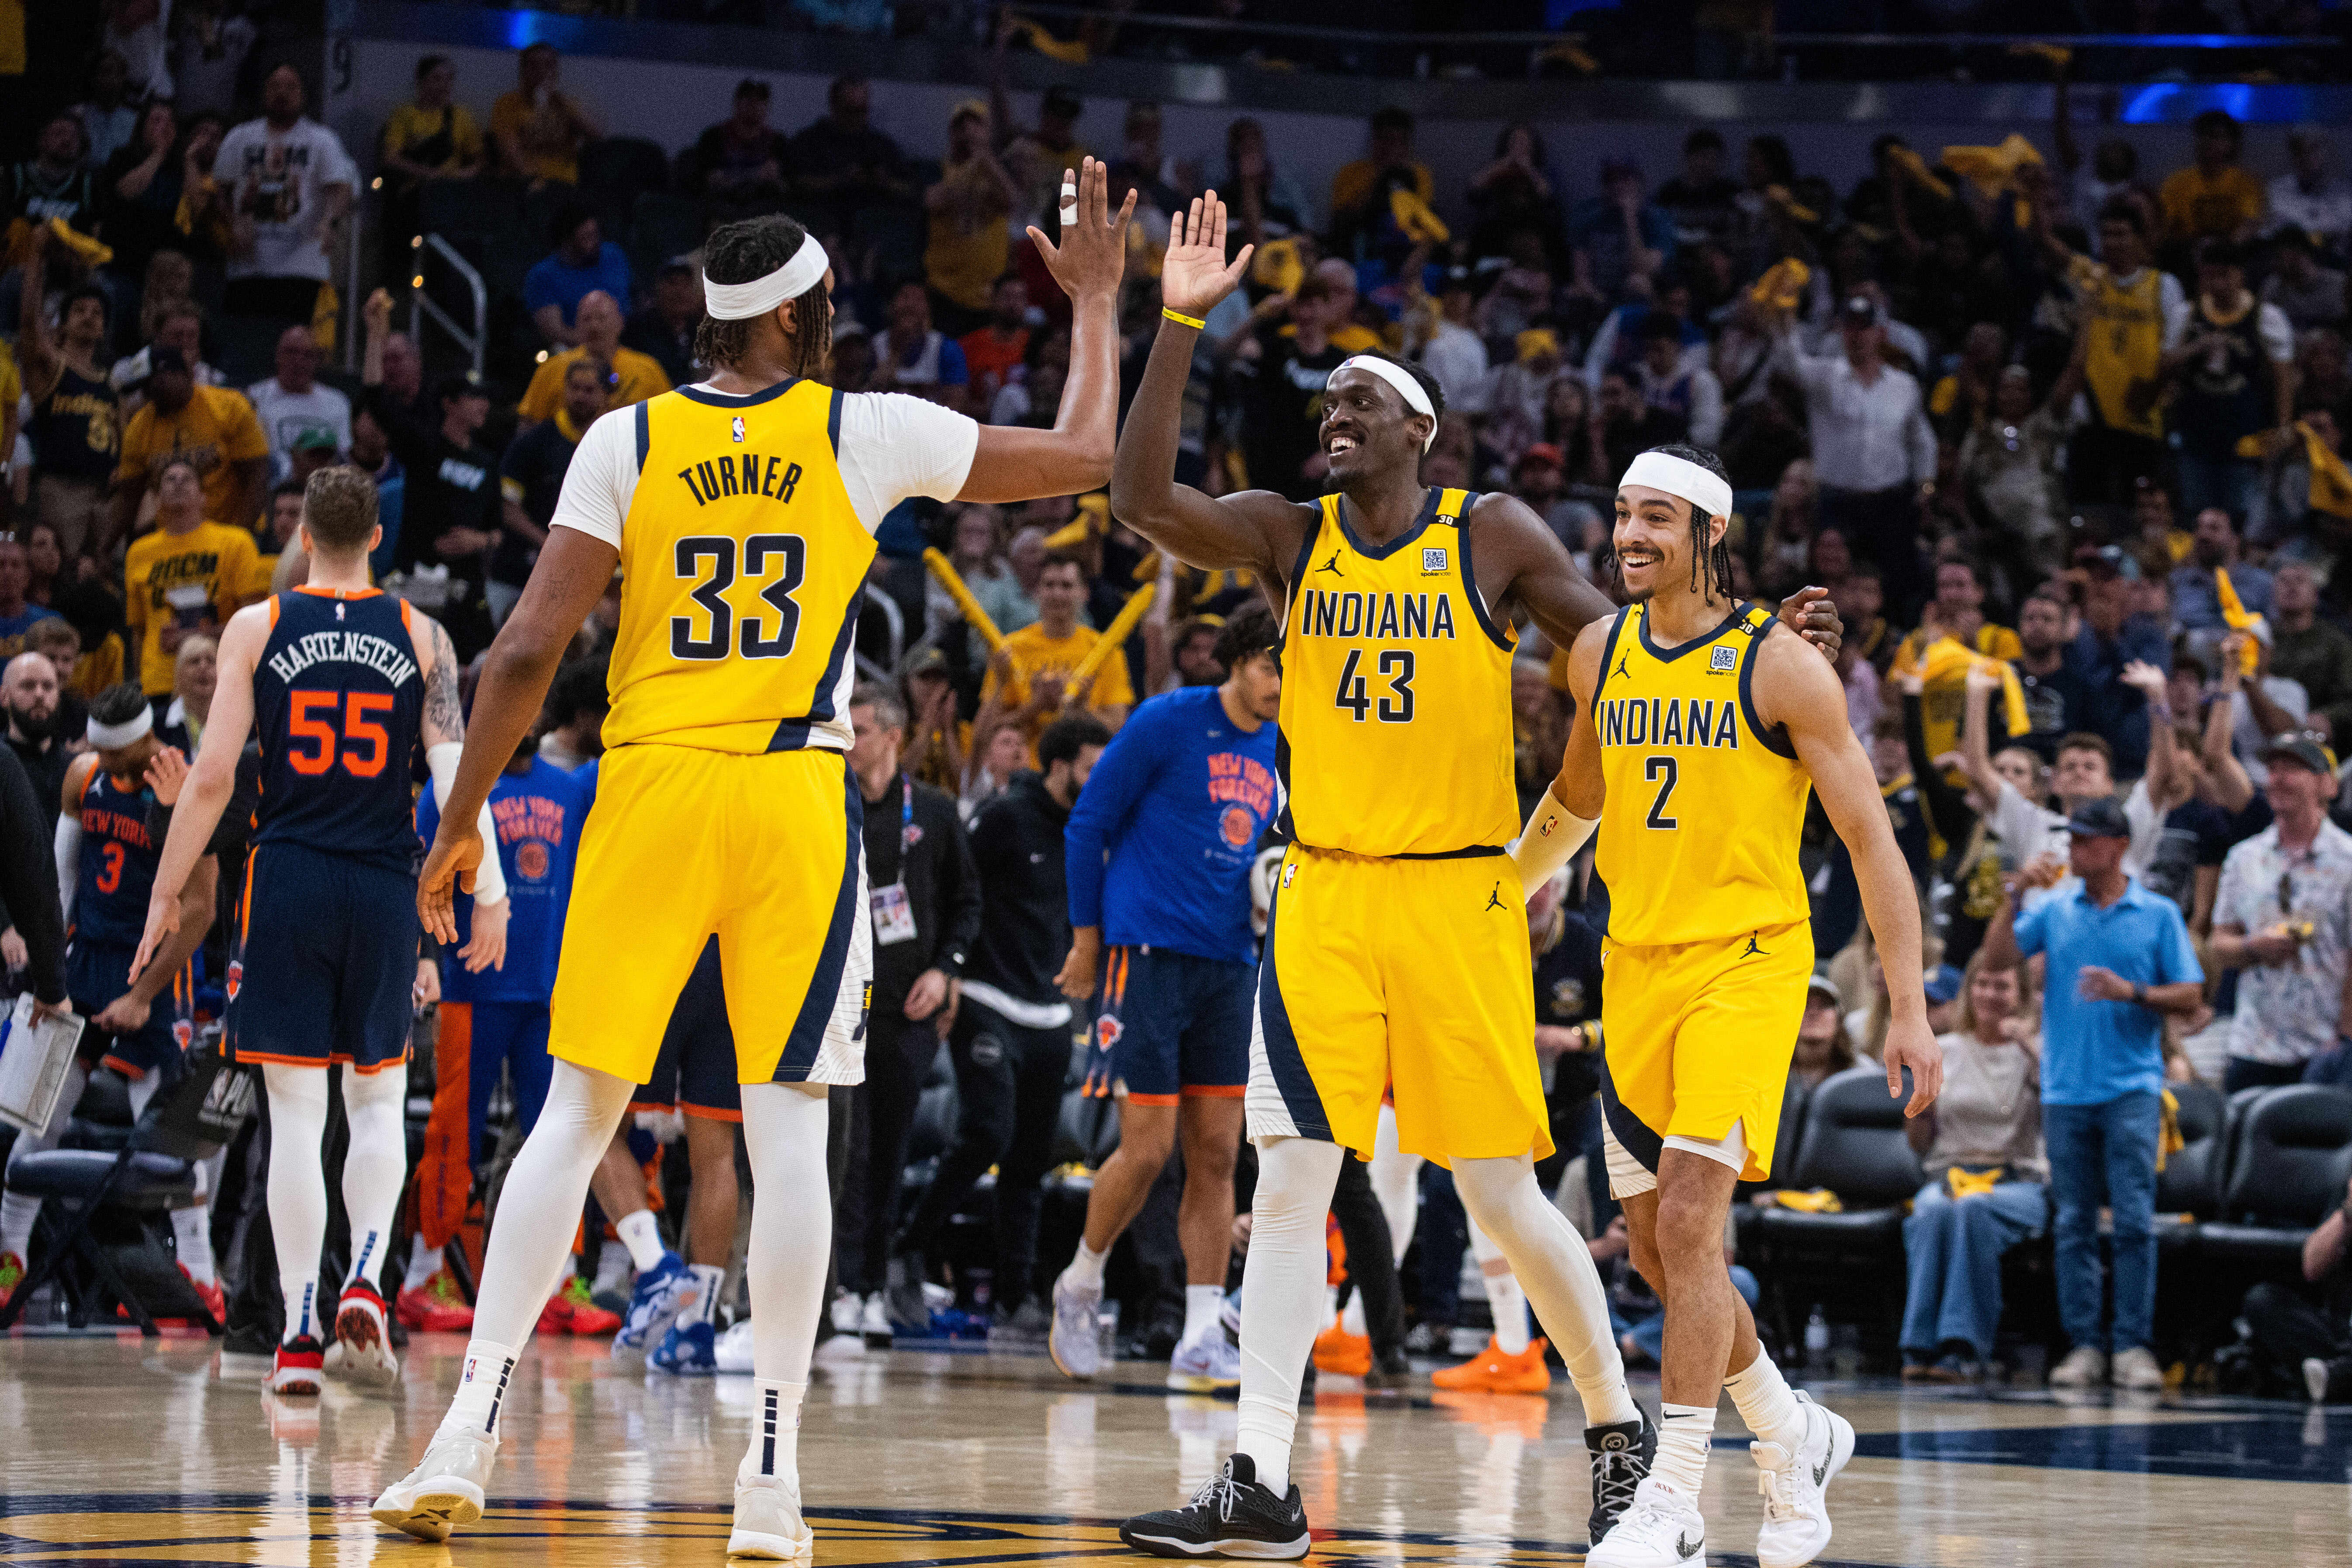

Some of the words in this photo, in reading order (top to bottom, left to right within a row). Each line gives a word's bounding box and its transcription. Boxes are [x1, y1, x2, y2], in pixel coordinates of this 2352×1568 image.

[678, 454, 802, 506] TURNER
[1439, 515, 1454, 526] 30
[670, 533, 807, 661] 33
[1301, 588, 1456, 640] INDIANA
[268, 631, 417, 688] HARTENSTEIN
[1335, 648, 1416, 723] 43
[289, 690, 394, 778] 55
[1600, 697, 1739, 750] INDIANA
[1644, 755, 1678, 830] 2
[82, 809, 111, 834] NEW
[96, 841, 125, 893] 3
[1654, 1482, 1674, 1495] BOOK
